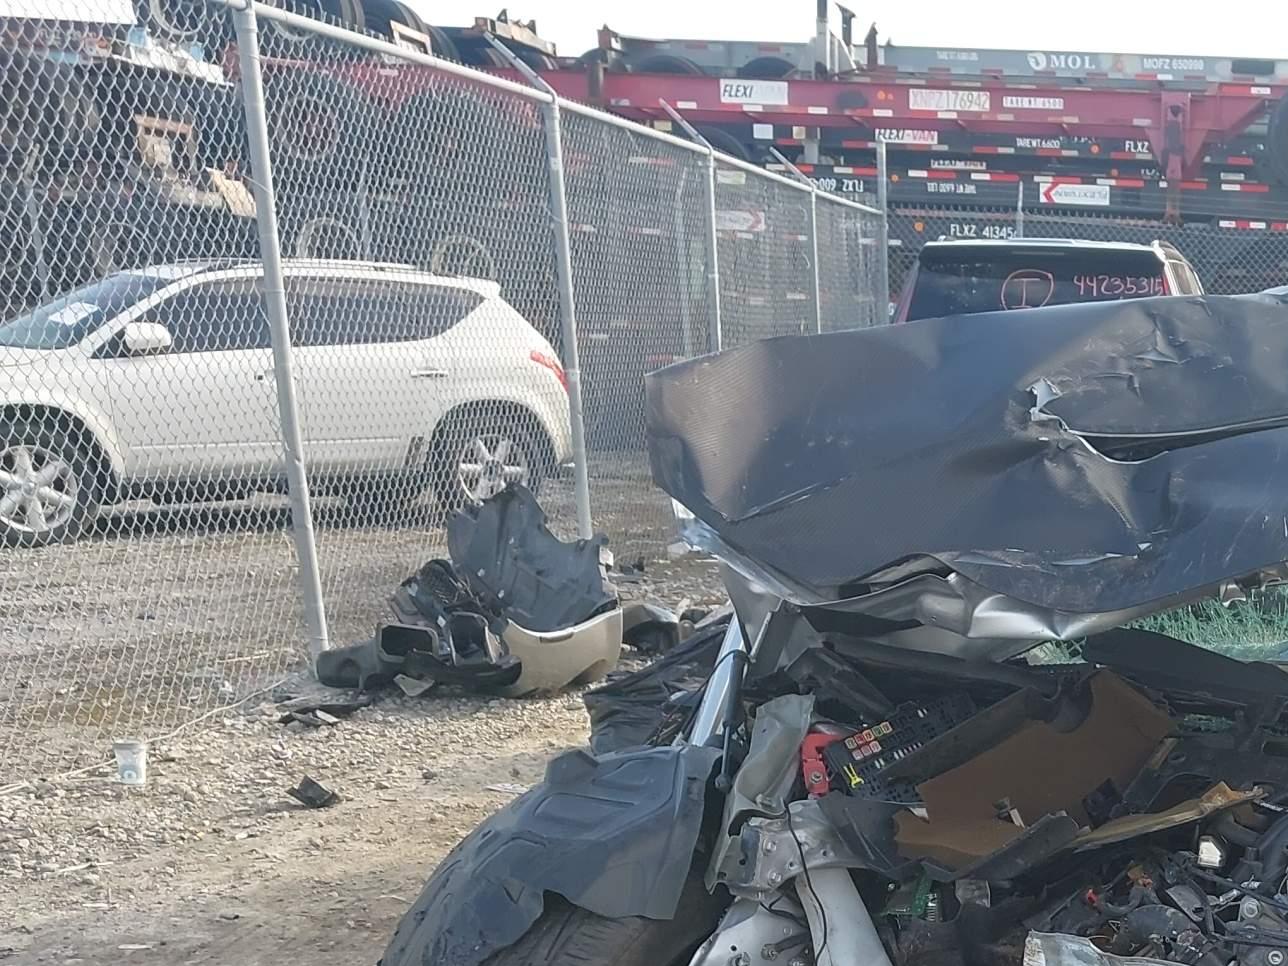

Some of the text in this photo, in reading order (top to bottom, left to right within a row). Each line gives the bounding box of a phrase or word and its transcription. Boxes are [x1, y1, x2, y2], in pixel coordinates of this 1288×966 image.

[1049, 56, 1096, 70] MOL
[1143, 58, 1170, 70] MOFZ
[722, 84, 754, 99] FLEXI
[1125, 141, 1149, 153] FLXZ
[842, 179, 864, 192] FLXZ
[950, 224, 977, 238] FLXZ
[1073, 275, 1164, 297] 44235315
